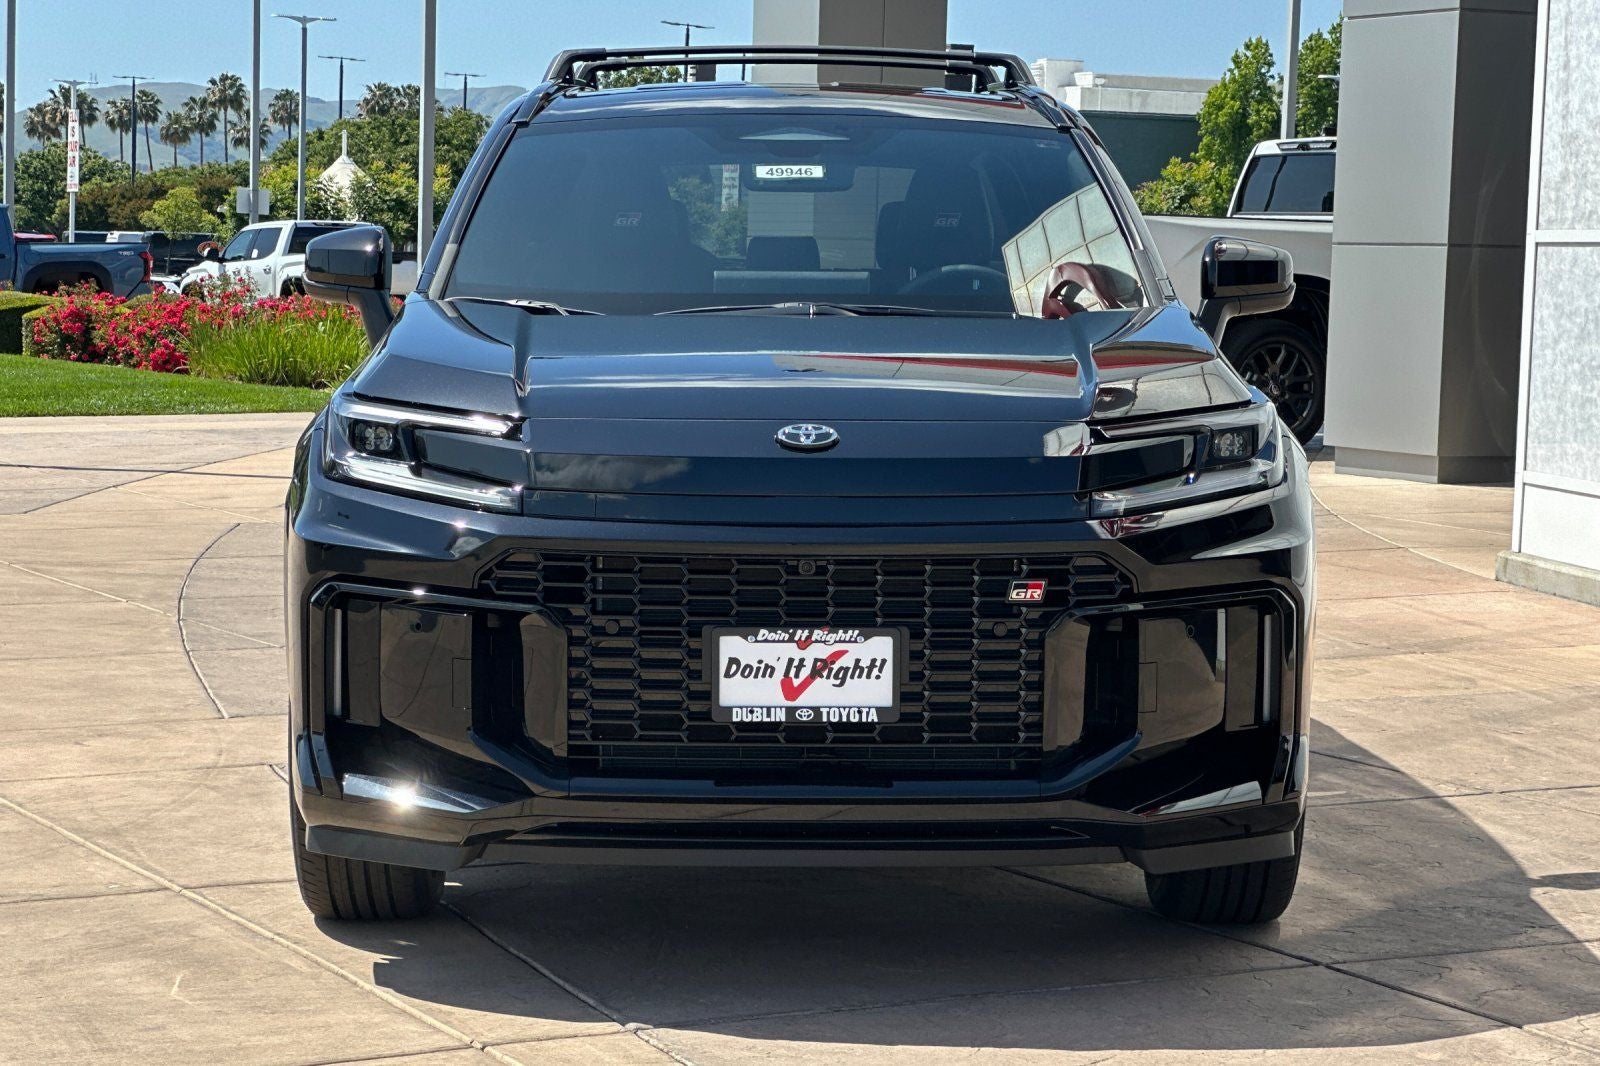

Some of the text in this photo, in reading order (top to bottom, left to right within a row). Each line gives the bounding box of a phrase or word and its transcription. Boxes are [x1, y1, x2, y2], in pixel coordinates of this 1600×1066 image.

[765, 167, 814, 176] 49946
[616, 217, 639, 225] GR
[936, 217, 960, 225] GR
[1011, 588, 1041, 599] GR
[757, 629, 859, 645] Doin' It Right!
[724, 657, 887, 688] Doin' It Right!
[732, 708, 878, 722] DUBLIN TOYOTA
